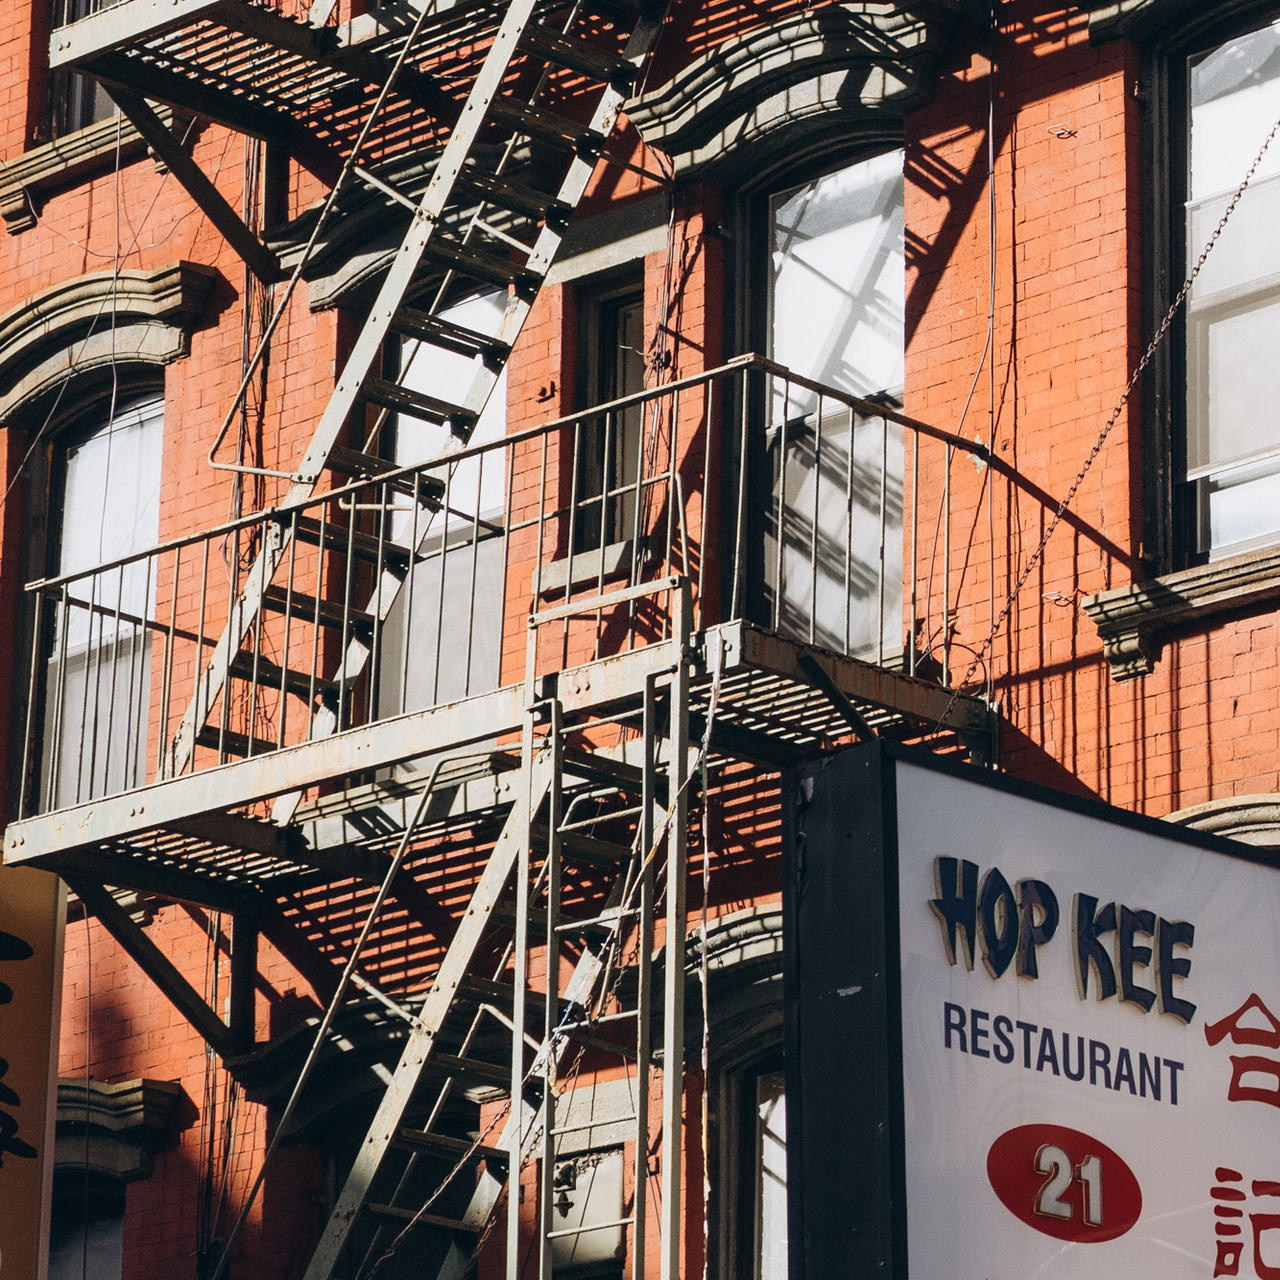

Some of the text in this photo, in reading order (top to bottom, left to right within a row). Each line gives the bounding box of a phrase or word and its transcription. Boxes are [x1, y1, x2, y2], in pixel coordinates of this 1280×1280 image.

[928, 854, 1198, 1025] HOP KEE
[943, 1000, 1186, 1107] RESTAURANT
[1032, 1142, 1107, 1229] 21
